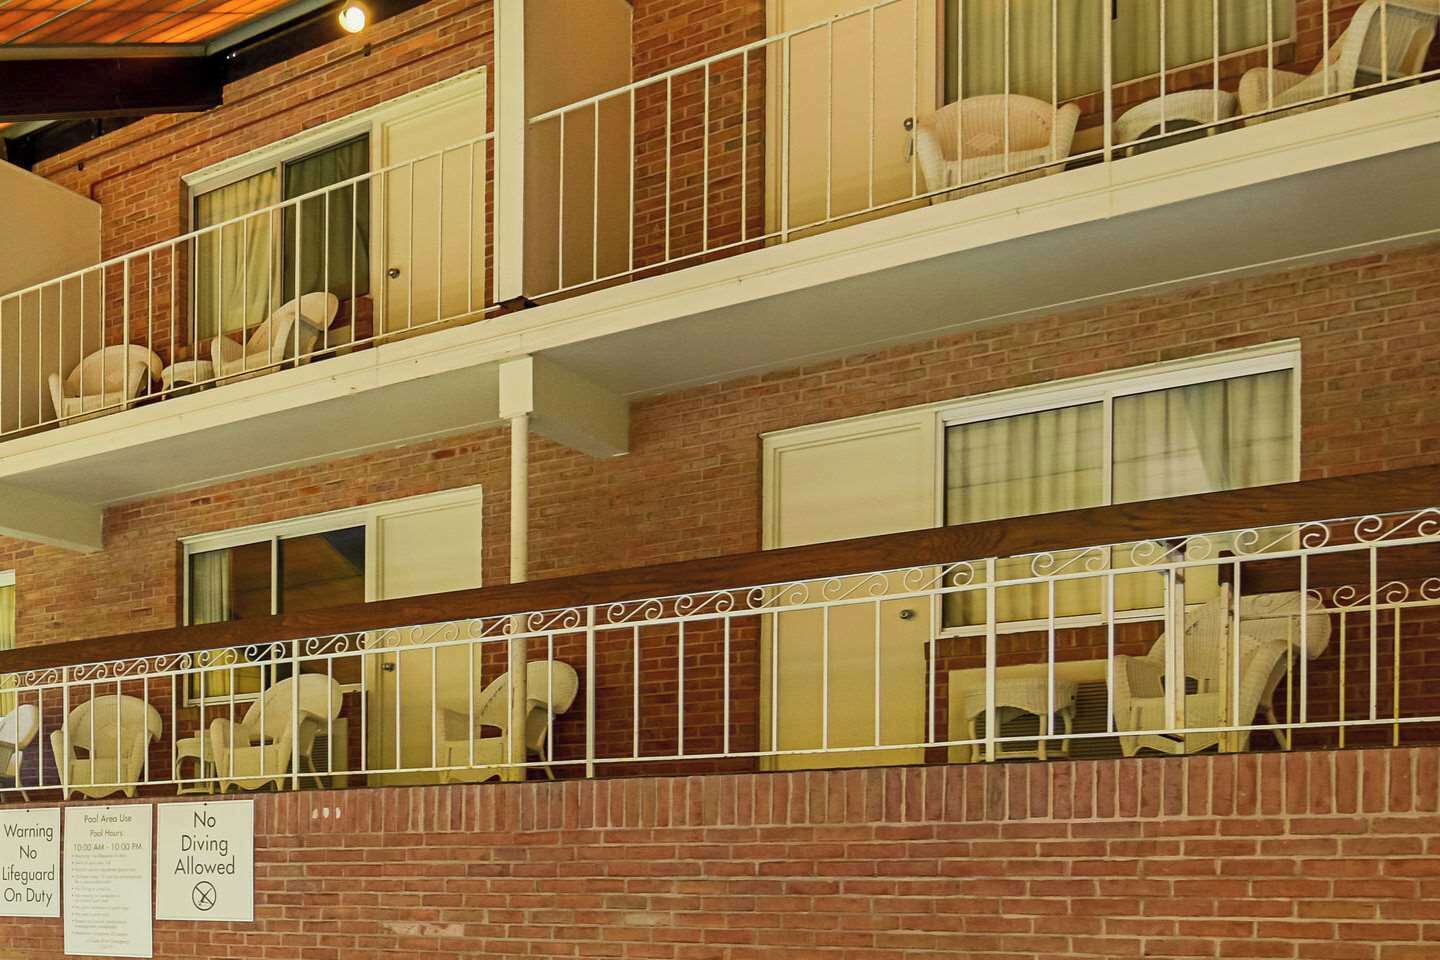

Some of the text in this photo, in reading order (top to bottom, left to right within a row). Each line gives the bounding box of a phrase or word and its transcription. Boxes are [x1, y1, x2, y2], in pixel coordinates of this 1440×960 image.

[84, 813, 132, 824] Pool Area Use
[193, 812, 216, 828] No
[3, 823, 54, 842] Warning
[19, 845, 38, 860] No
[181, 834, 228, 857] Diving
[2, 865, 55, 886] Lifeguard
[174, 856, 236, 876] Allowed
[4, 887, 53, 907] On Duty
